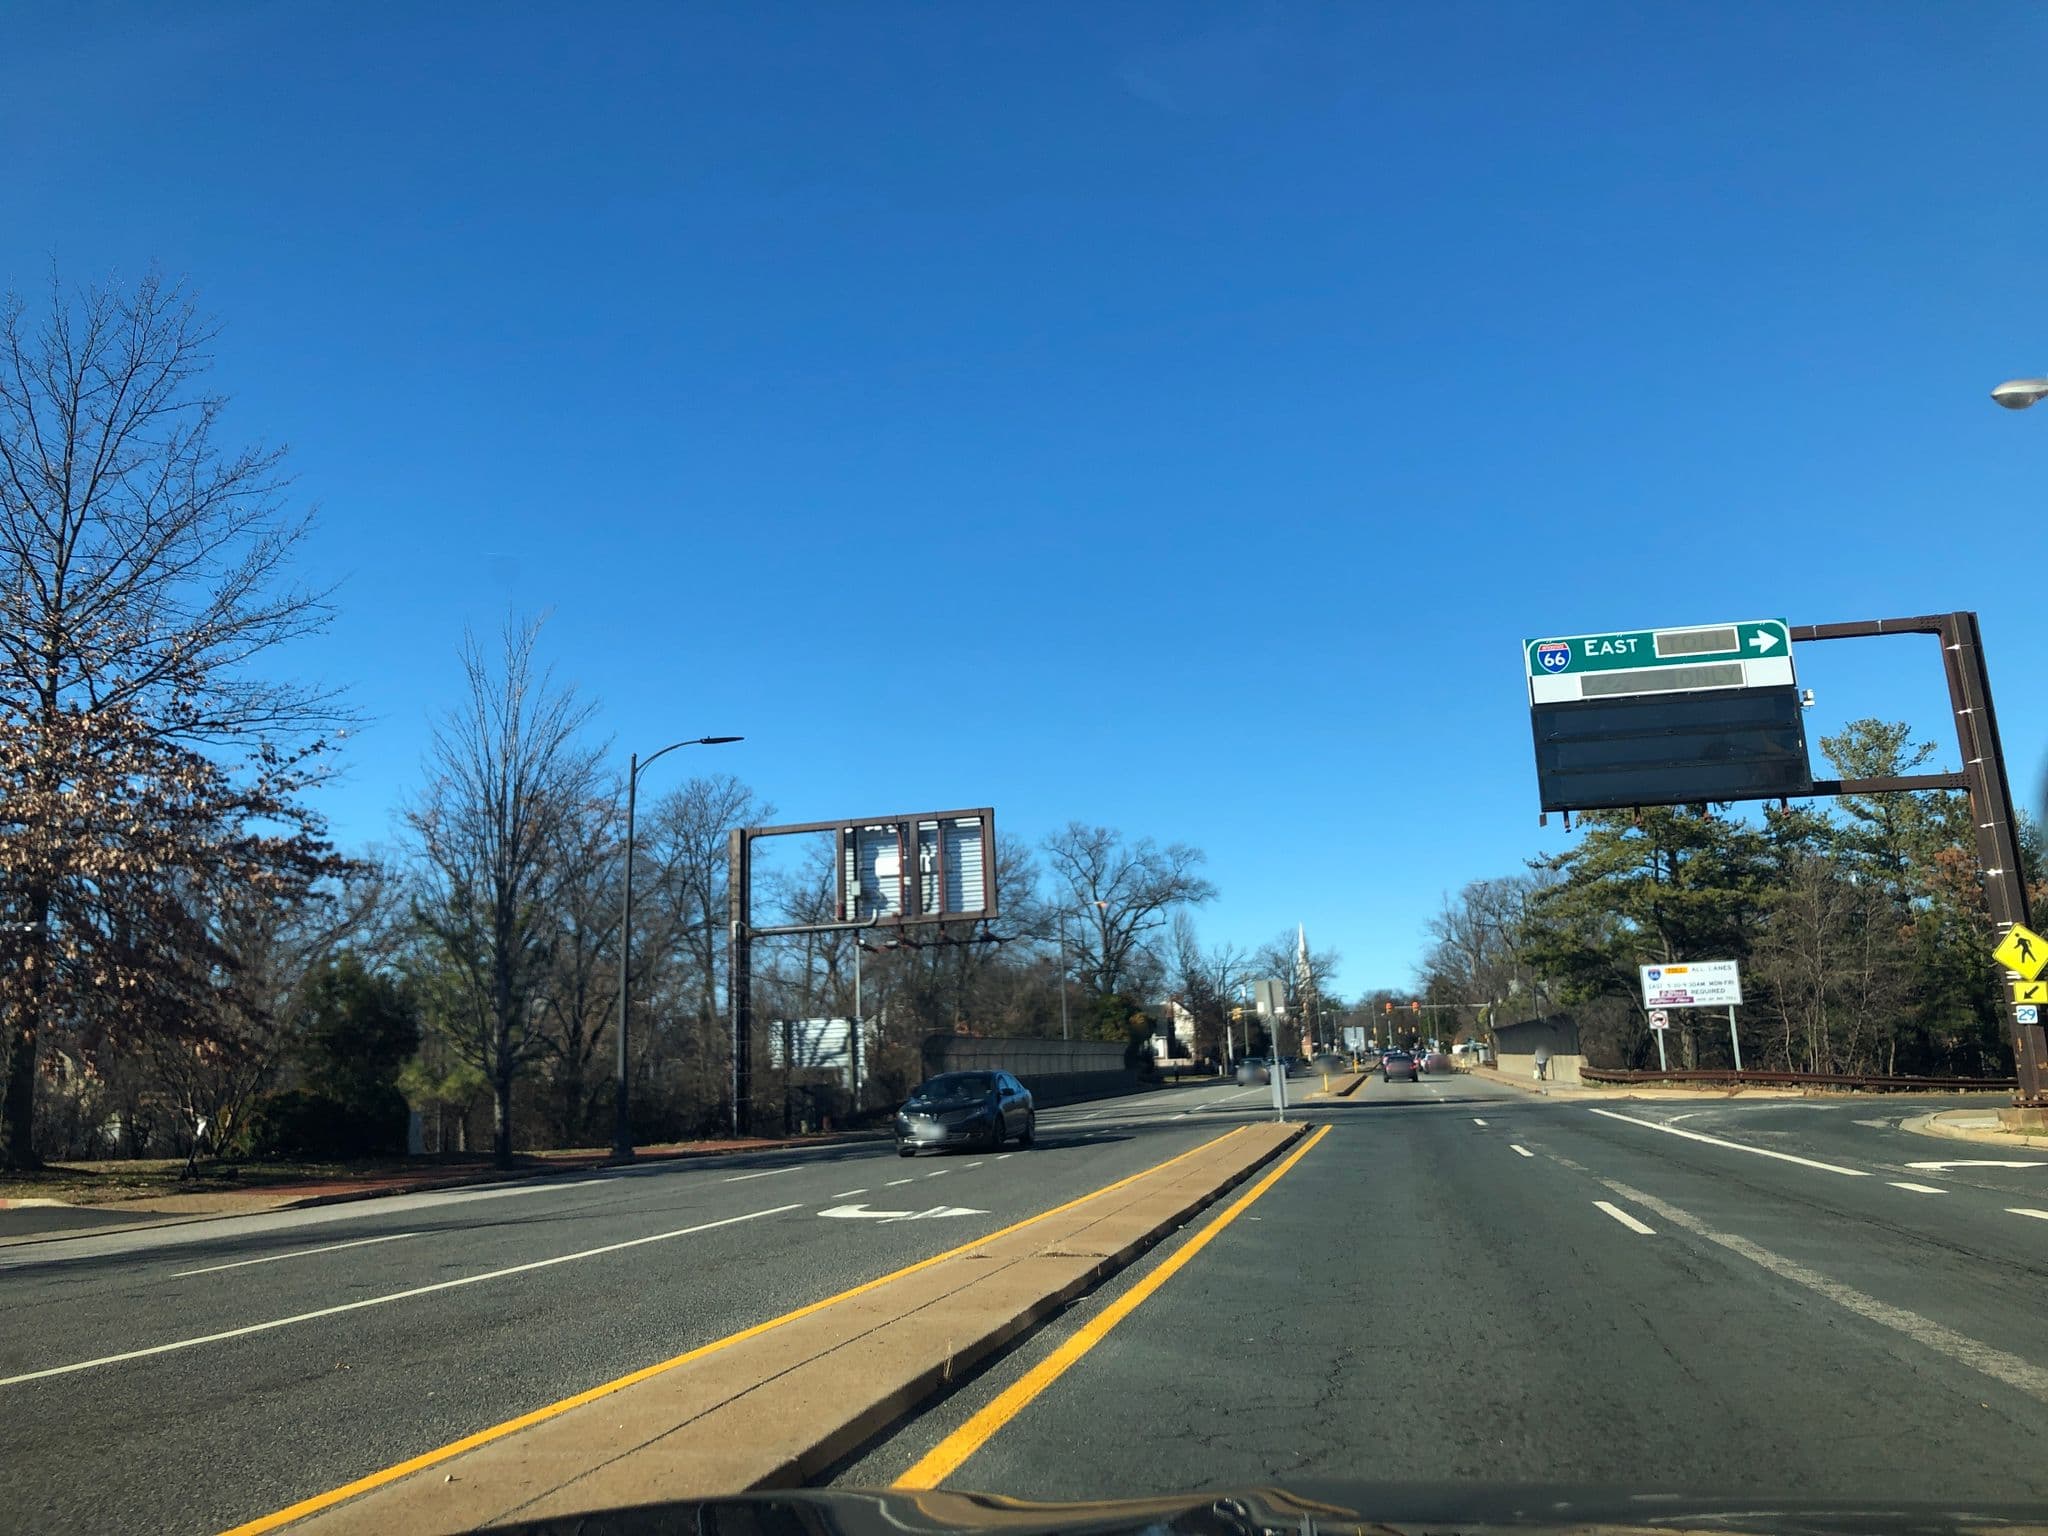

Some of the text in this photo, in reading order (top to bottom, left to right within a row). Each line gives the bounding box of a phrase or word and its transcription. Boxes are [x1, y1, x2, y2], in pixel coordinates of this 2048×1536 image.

[1584, 638, 1638, 656] EAST
[1544, 652, 1565, 667] 66
[1679, 667, 1737, 687] ONLY
[2018, 1009, 2035, 1020] 29
